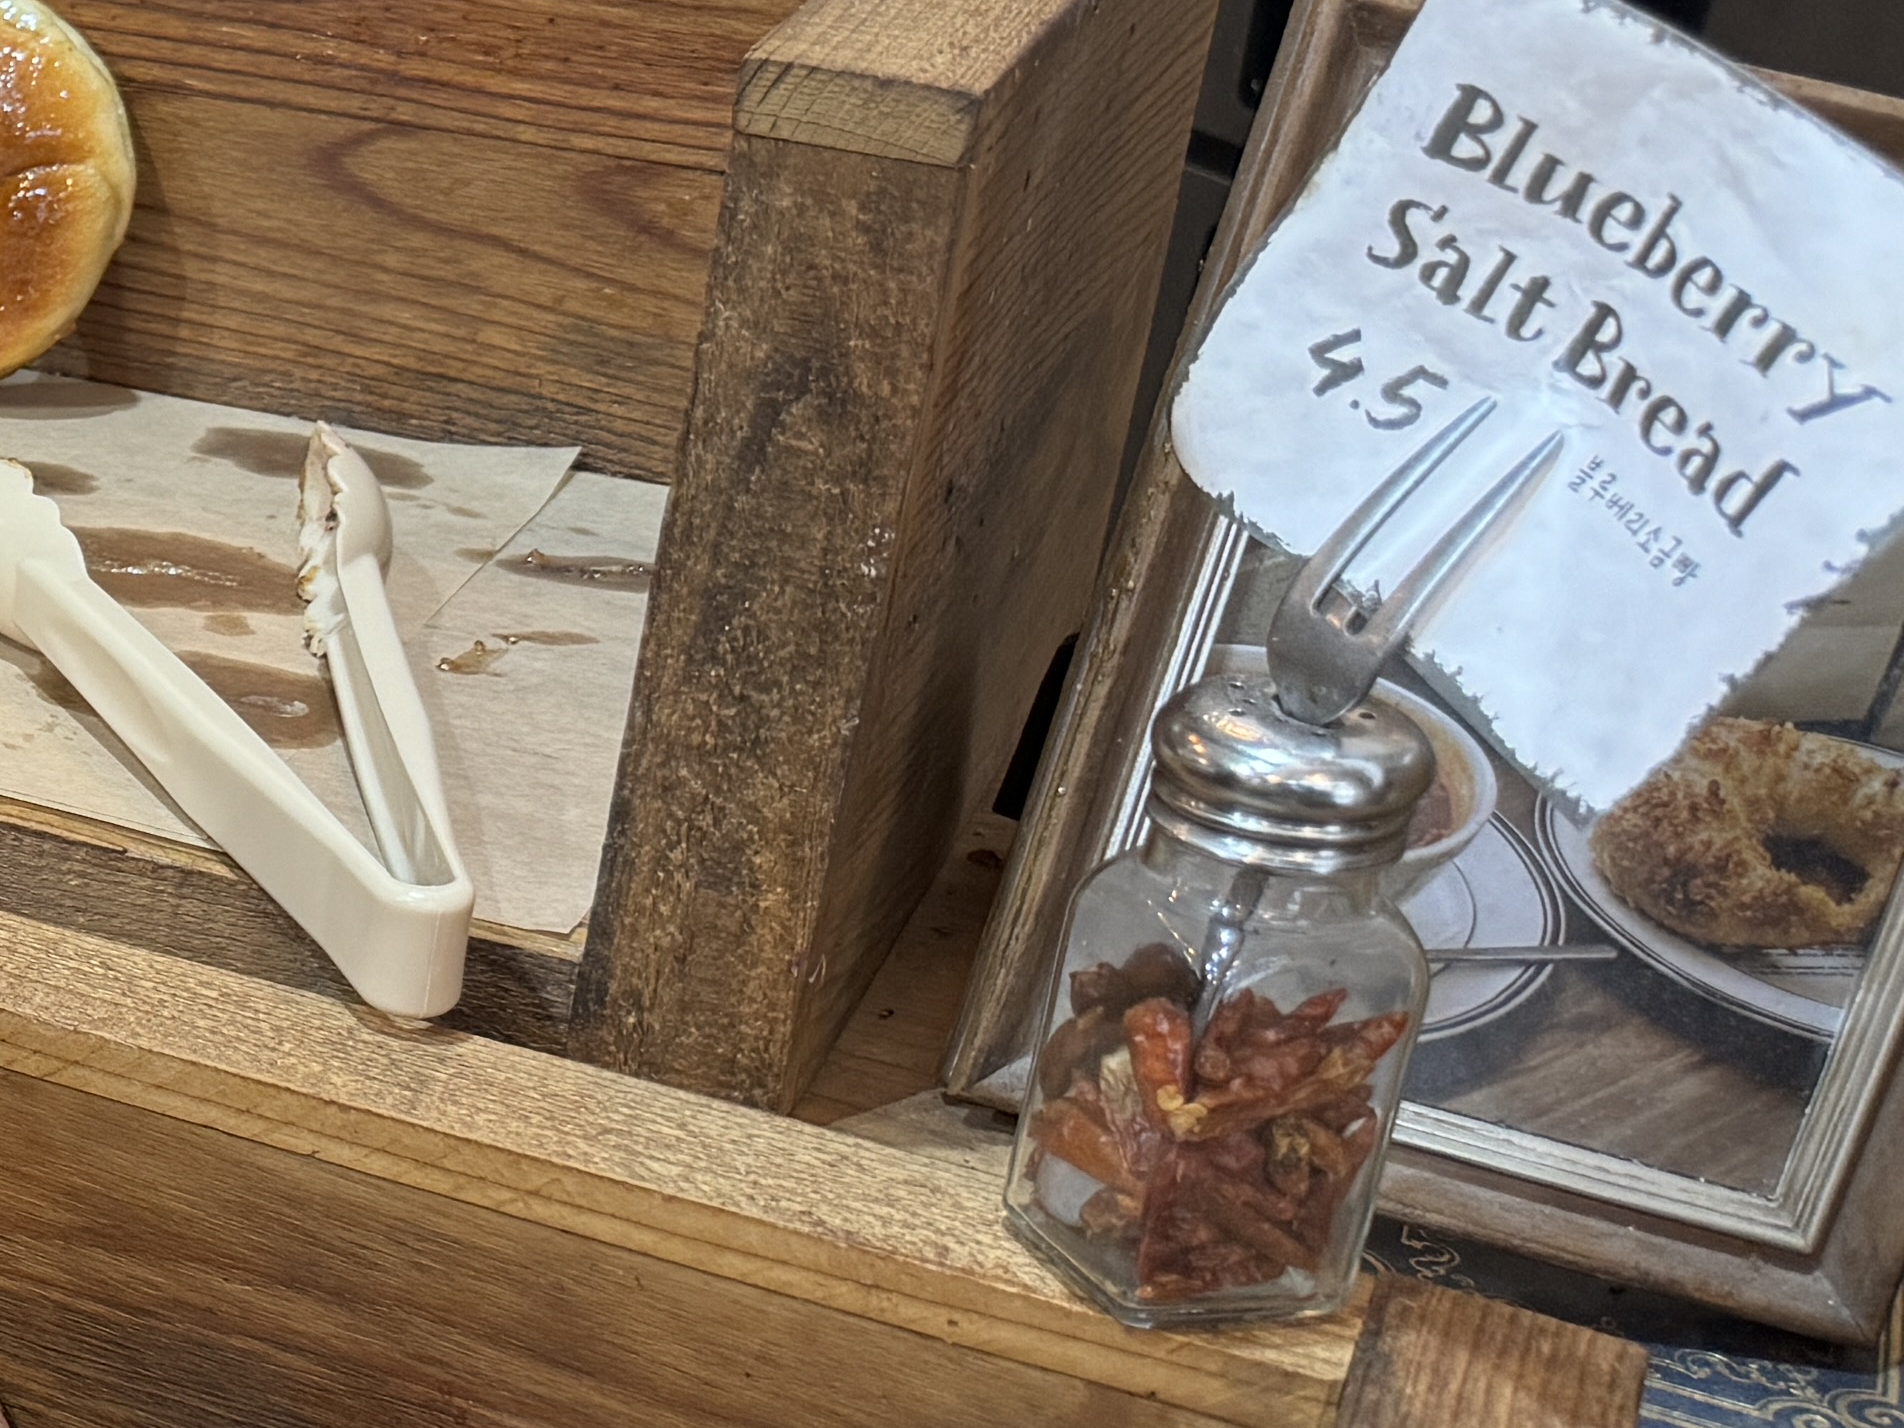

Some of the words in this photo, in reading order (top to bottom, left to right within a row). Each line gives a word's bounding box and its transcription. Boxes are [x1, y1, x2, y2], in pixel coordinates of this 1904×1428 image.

[1307, 327, 1449, 431] 4.5
[1366, 199, 1557, 342] Salt
[1552, 300, 1801, 539] Bread
[1421, 83, 1894, 425] Blueberry
